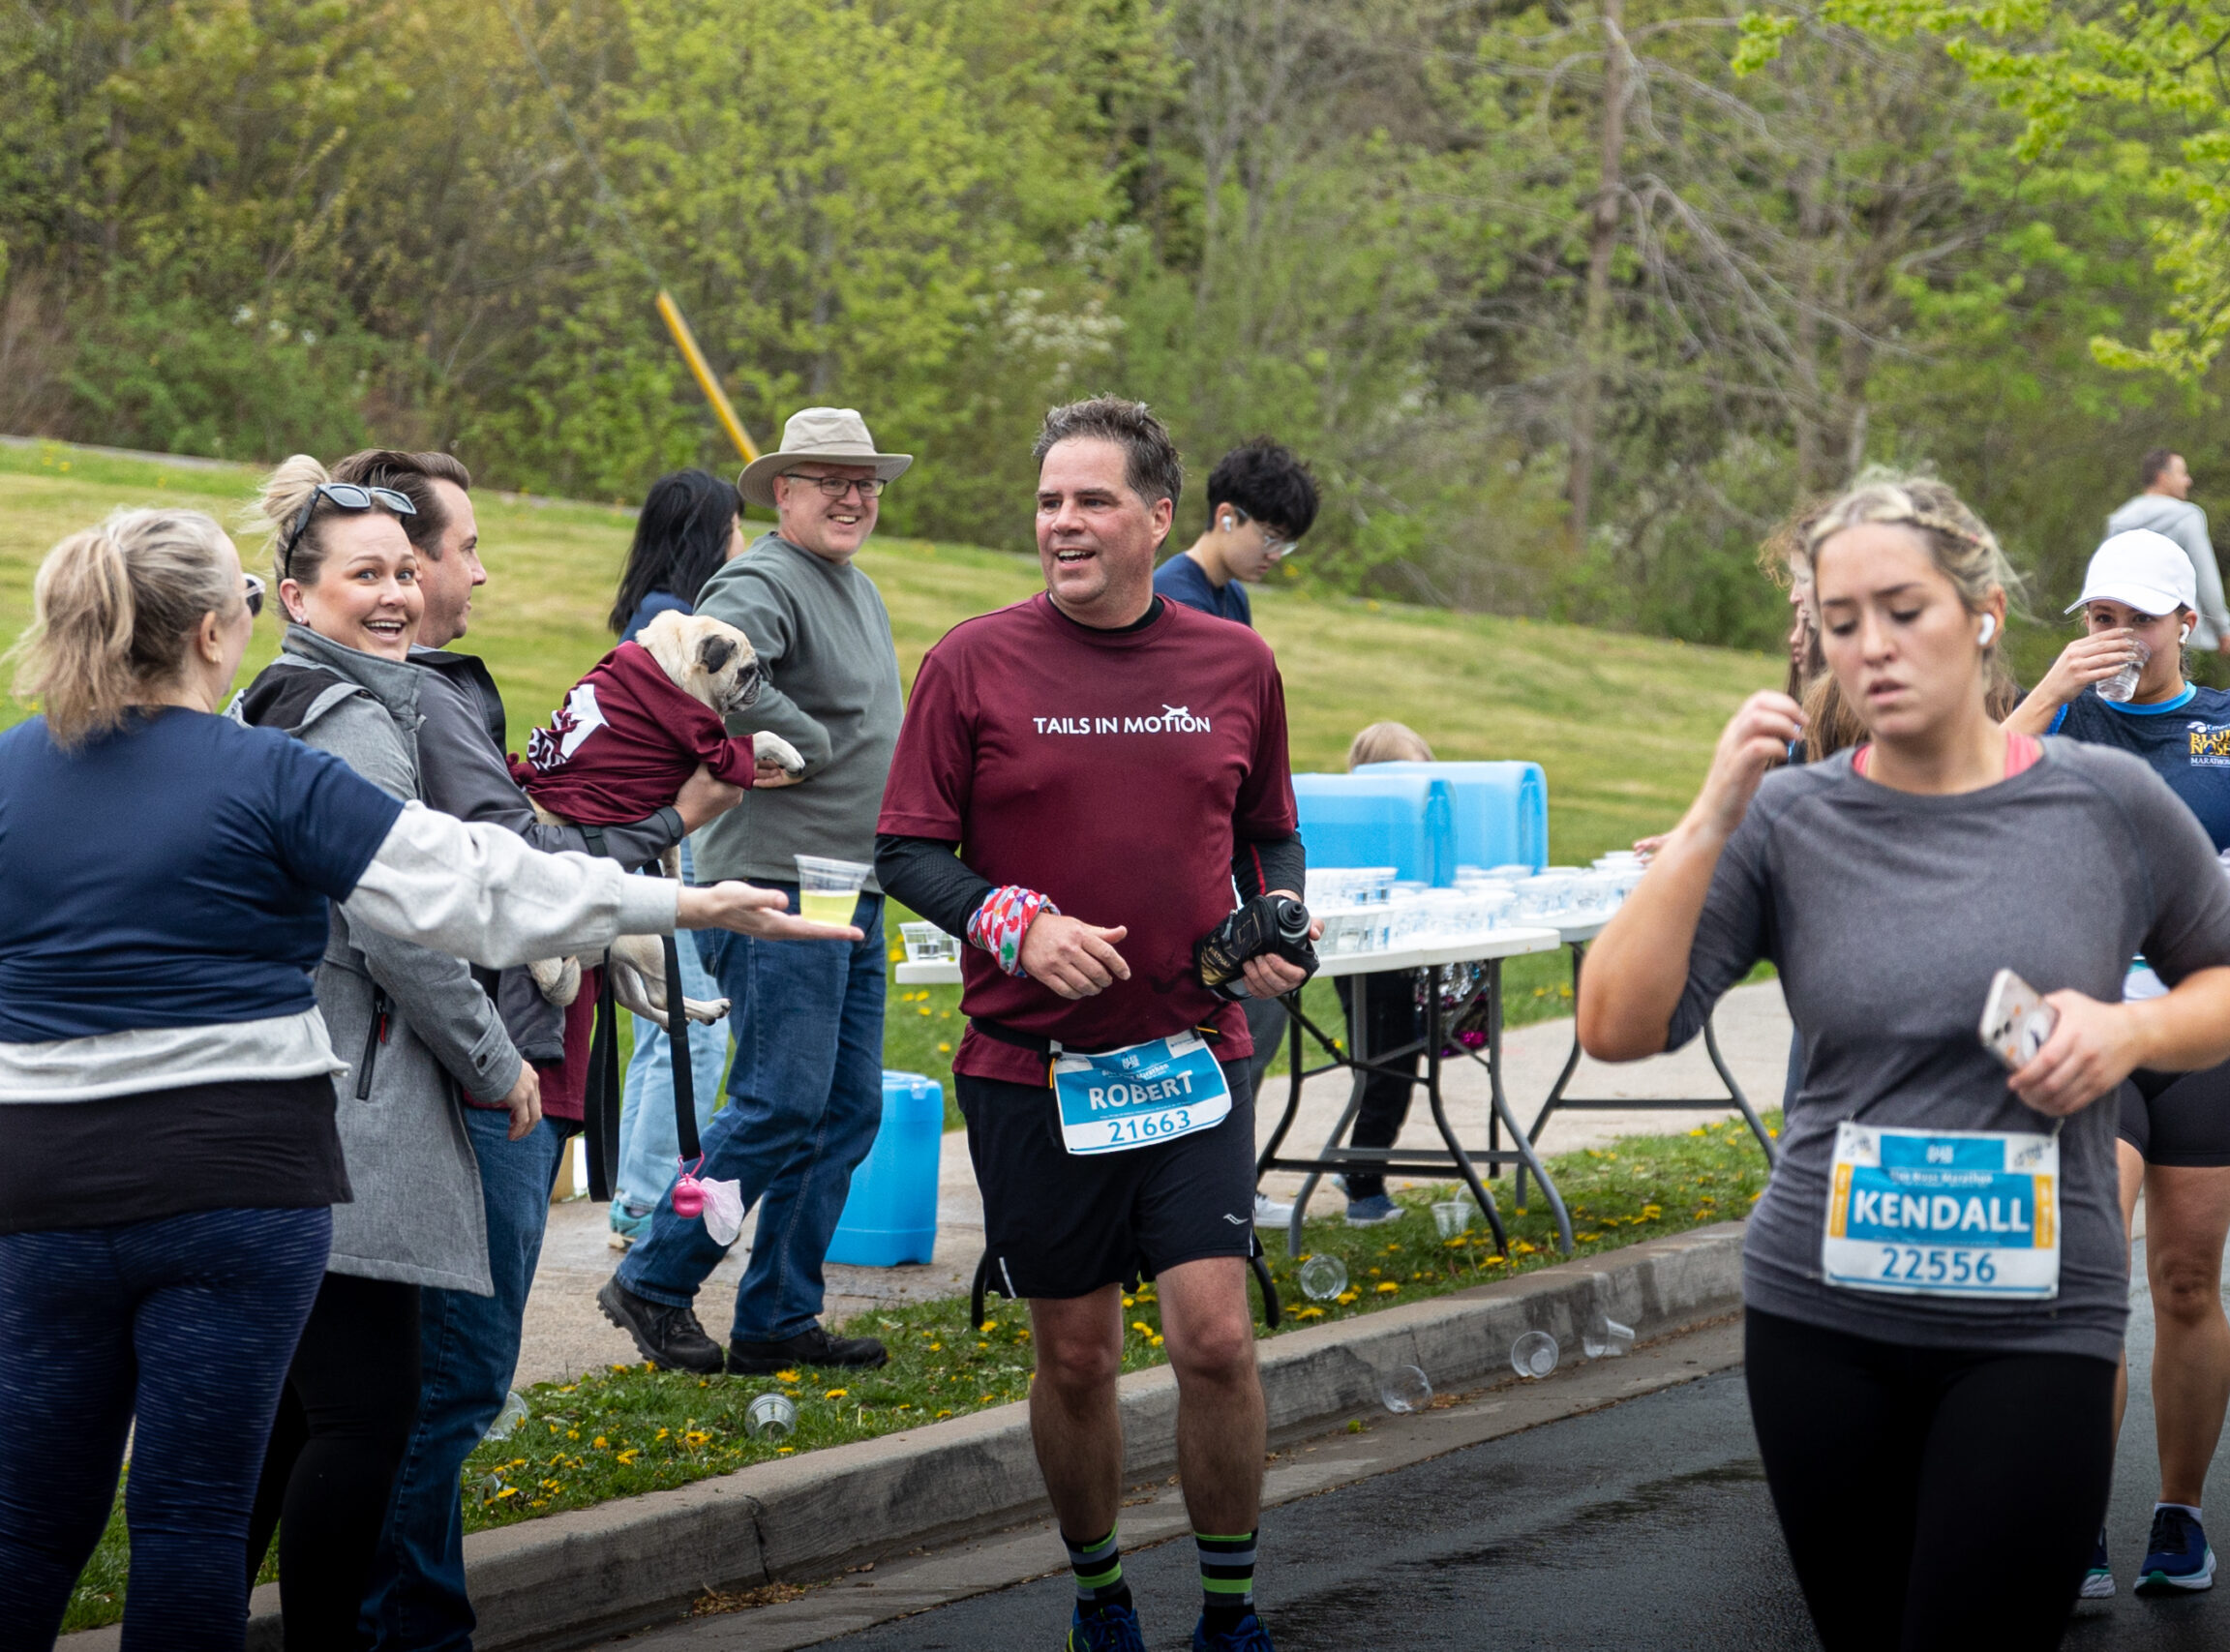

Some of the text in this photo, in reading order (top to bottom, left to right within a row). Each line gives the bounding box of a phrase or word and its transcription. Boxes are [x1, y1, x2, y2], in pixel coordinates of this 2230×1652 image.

[1033, 715, 1211, 735] TAILS IN MOTION
[2190, 740, 2230, 755] NOSE
[1088, 1069, 1193, 1111] ROBERT
[1107, 1109, 1191, 1143] 21663
[1853, 1189, 2032, 1233] KENDALL
[1881, 1247, 1997, 1283] 22556
